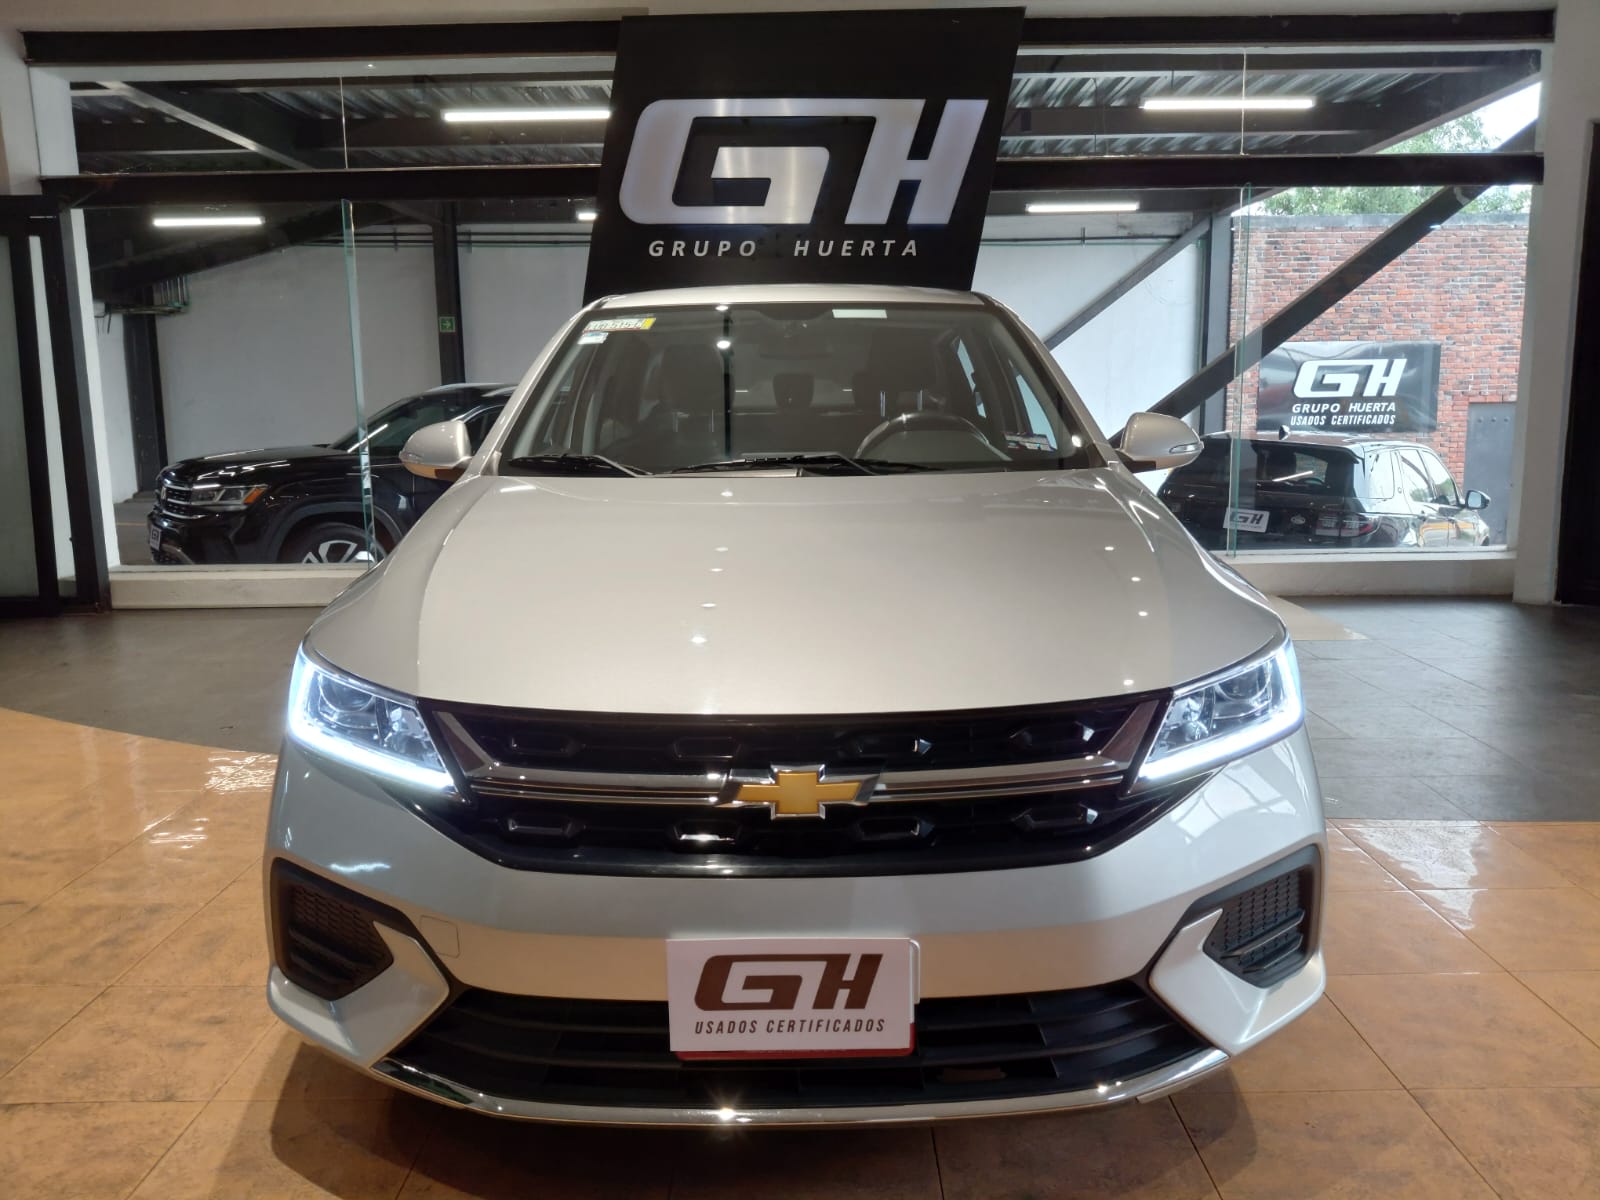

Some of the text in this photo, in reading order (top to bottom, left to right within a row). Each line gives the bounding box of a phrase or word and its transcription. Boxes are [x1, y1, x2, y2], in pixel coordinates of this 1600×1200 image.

[619, 99, 988, 224] GH
[648, 239, 918, 257] GRUPO HUERTA
[1293, 358, 1408, 398] GH
[1292, 402, 1396, 413] GRUPO HUERTA
[1290, 414, 1396, 425] USADOS CERTIFICADOS
[1230, 511, 1264, 524] GH
[694, 953, 883, 1011] GH
[695, 1018, 885, 1034] USADOS CERTIFICADOS
